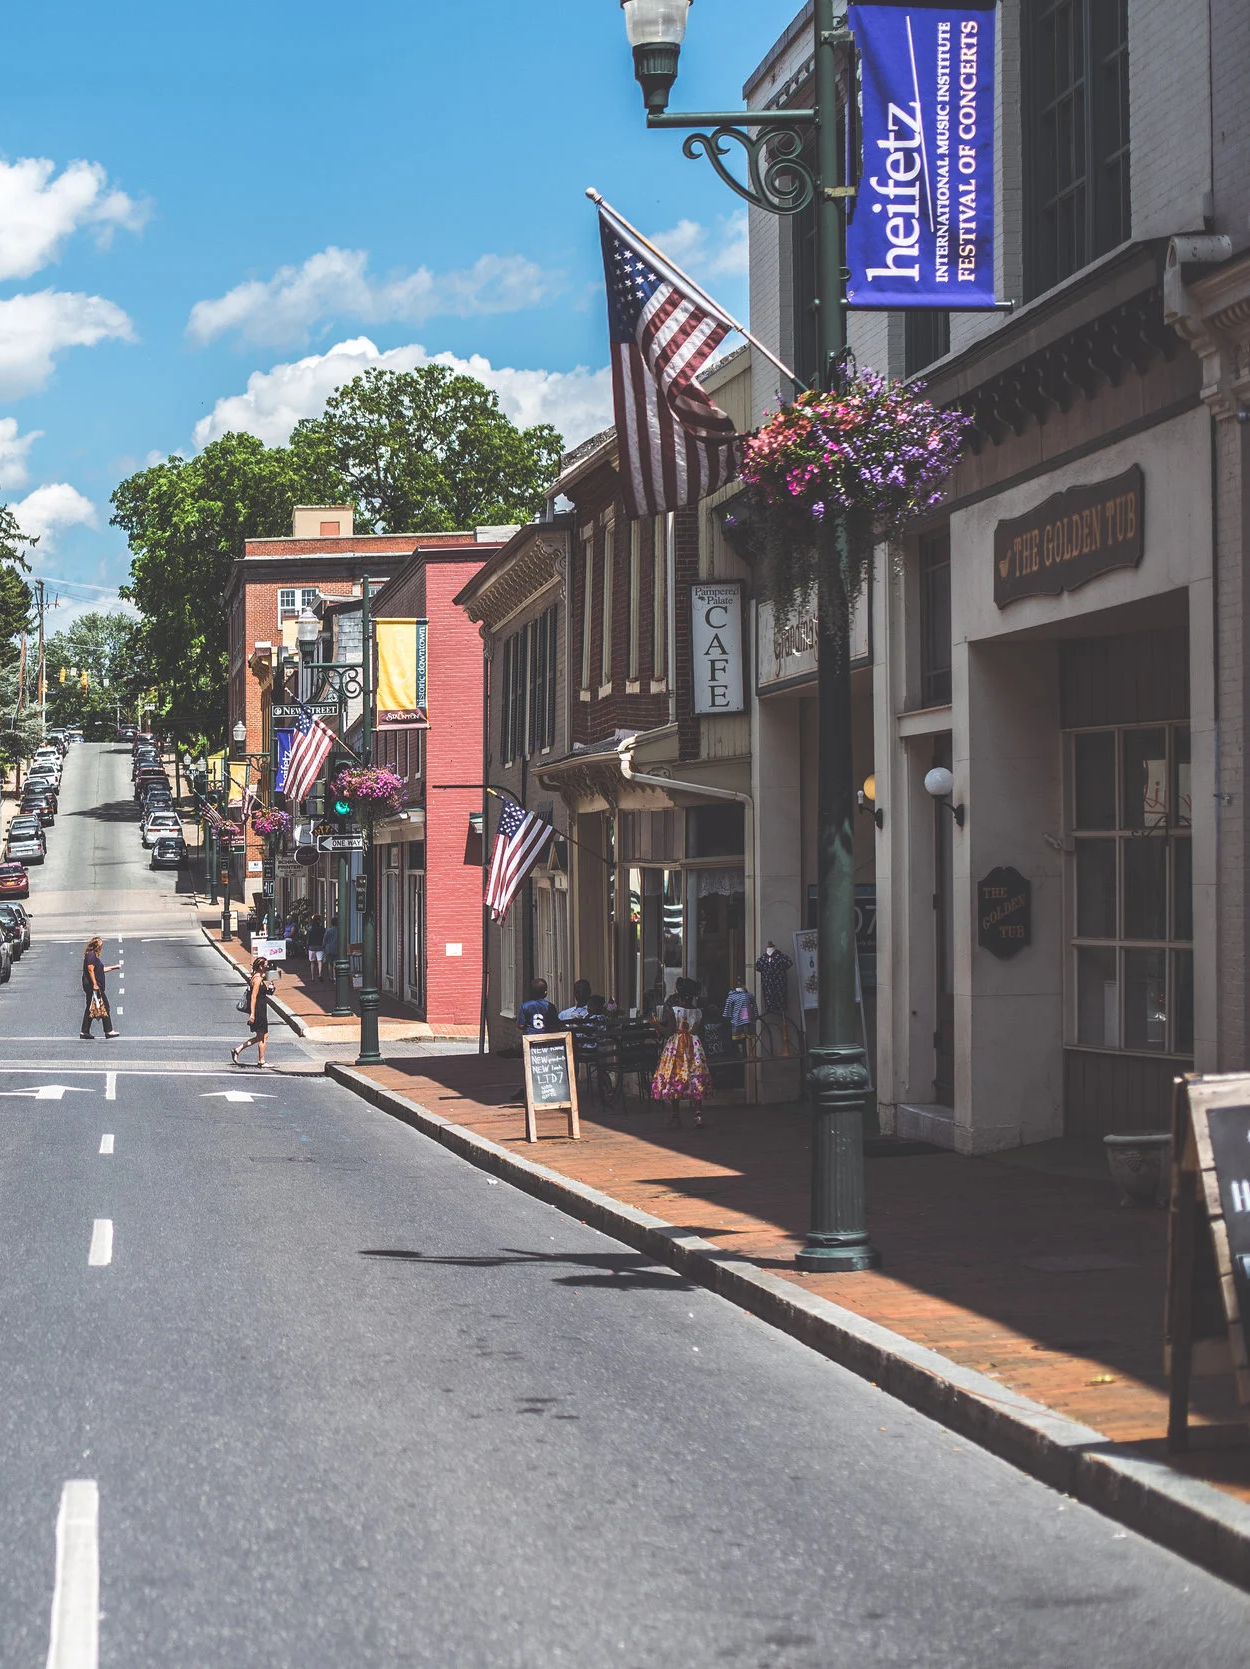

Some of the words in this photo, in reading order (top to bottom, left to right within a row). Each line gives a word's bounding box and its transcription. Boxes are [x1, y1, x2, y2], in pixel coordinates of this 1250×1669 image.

[937, 22, 951, 105] INSTITUTE
[958, 20, 978, 141] CONCERTS
[936, 107, 950, 155] MUSIC
[958, 145, 976, 175] OF
[865, 101, 922, 282] heifetz
[936, 157, 950, 283] INTERNATIONAL
[958, 178, 976, 282] FESTIVAL
[1014, 529, 1039, 578] THE
[1044, 504, 1102, 567] GOLDEN
[1105, 491, 1136, 546] TUB
[417, 626, 426, 674] downtown
[703, 605, 731, 708] CAFE
[309, 706, 336, 714] TREET
[417, 675, 425, 708] historic
[982, 887, 1007, 899] THE
[982, 894, 1026, 930] GOLDEN
[999, 925, 1025, 938] TUB
[532, 1013, 544, 1029] 6
